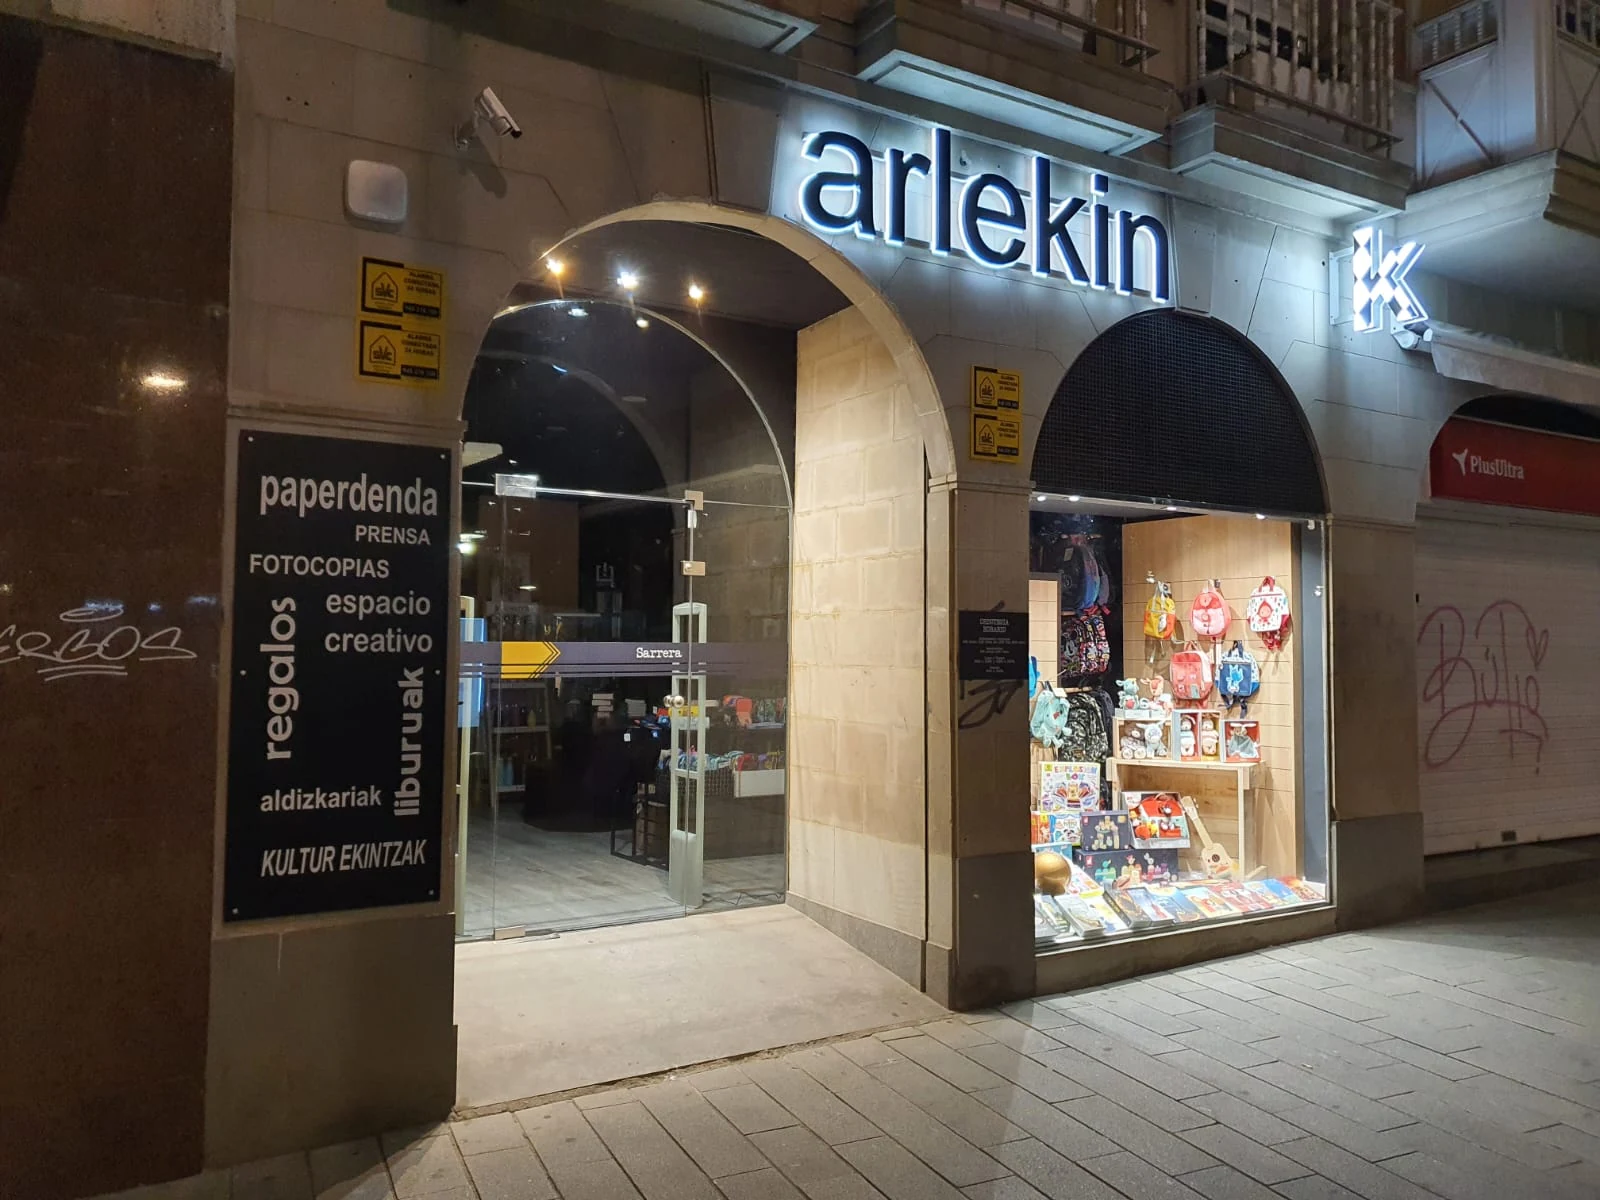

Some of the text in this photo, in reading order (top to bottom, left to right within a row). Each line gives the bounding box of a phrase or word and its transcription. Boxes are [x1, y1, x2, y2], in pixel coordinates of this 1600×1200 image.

[800, 126, 1170, 302] arlekin
[1470, 455, 1525, 480] PlusUltra
[260, 472, 438, 518] paperdenda
[355, 524, 431, 545] PRENSA
[249, 553, 390, 579] FOTOCOPIAS
[326, 590, 431, 621] espacio
[324, 627, 433, 653] creativo
[636, 646, 683, 659] Sarrera
[260, 596, 300, 760] regalos
[393, 666, 424, 816] liburuak
[260, 785, 382, 812] aldizkariak
[260, 839, 427, 877] KULTUR EKINTZAK
